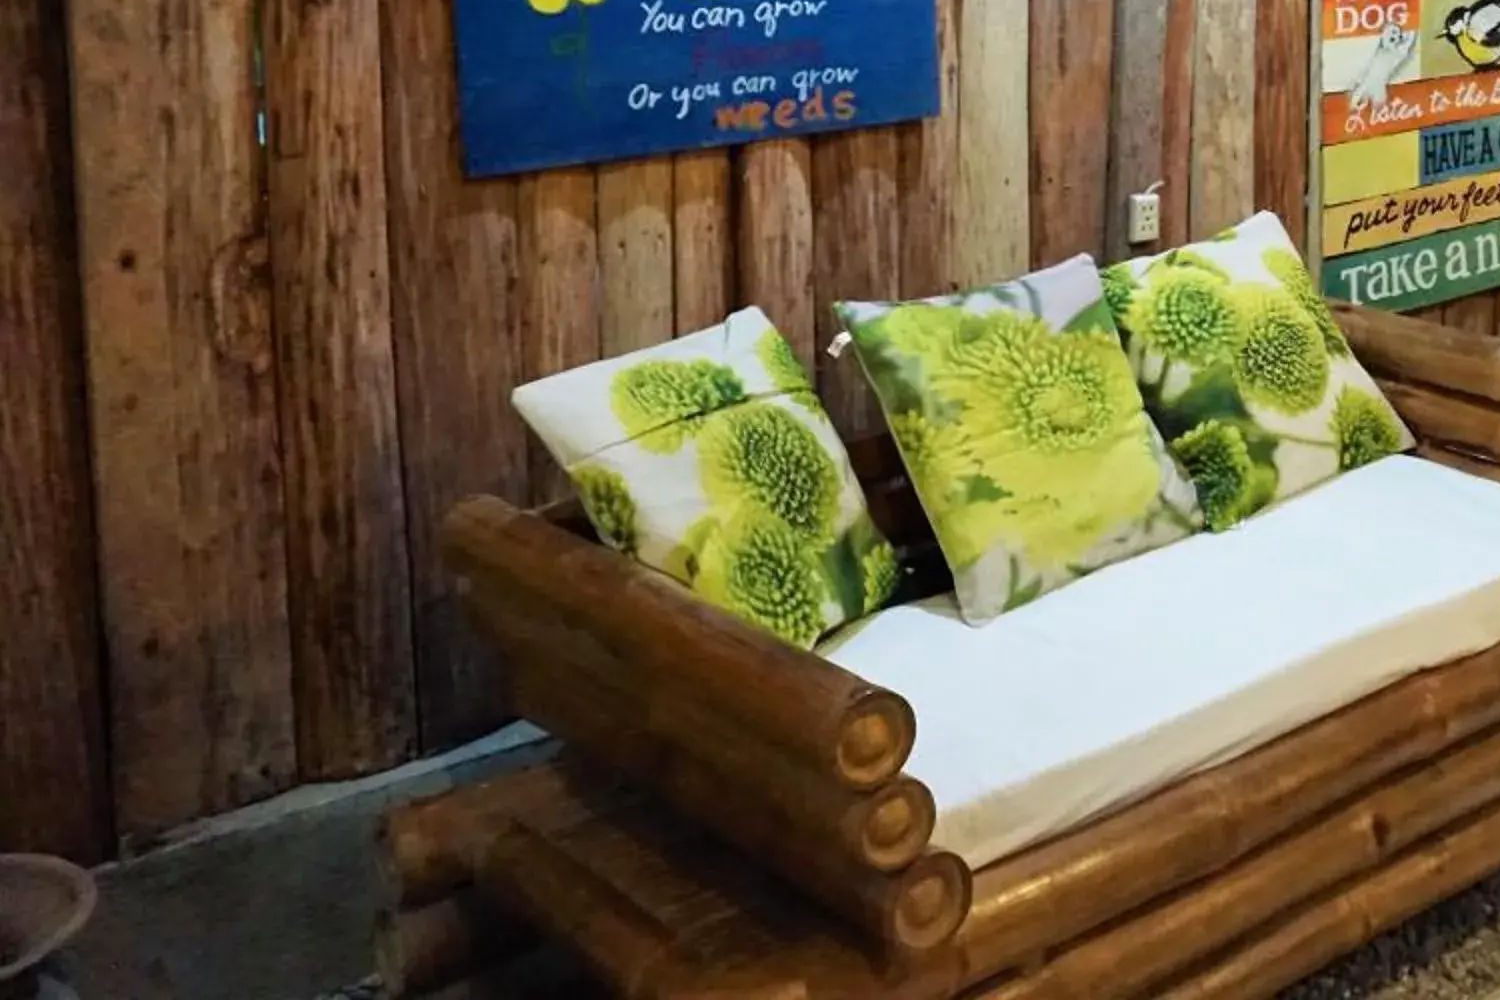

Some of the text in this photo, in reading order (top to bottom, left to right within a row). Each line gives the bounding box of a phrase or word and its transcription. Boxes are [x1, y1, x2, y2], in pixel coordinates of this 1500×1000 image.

[640, 0, 828, 38] You can grow
[1335, 2, 1409, 34] DOG
[628, 66, 859, 120] Or you can grow
[714, 87, 856, 130] weeds
[1345, 92, 1424, 134] Listen
[1429, 90, 1452, 114] to
[1455, 83, 1488, 107] the
[1423, 127, 1475, 176] HAVE
[1479, 123, 1495, 164] A
[1344, 199, 1399, 248] put
[1403, 191, 1459, 233] your
[1444, 240, 1471, 280] a
